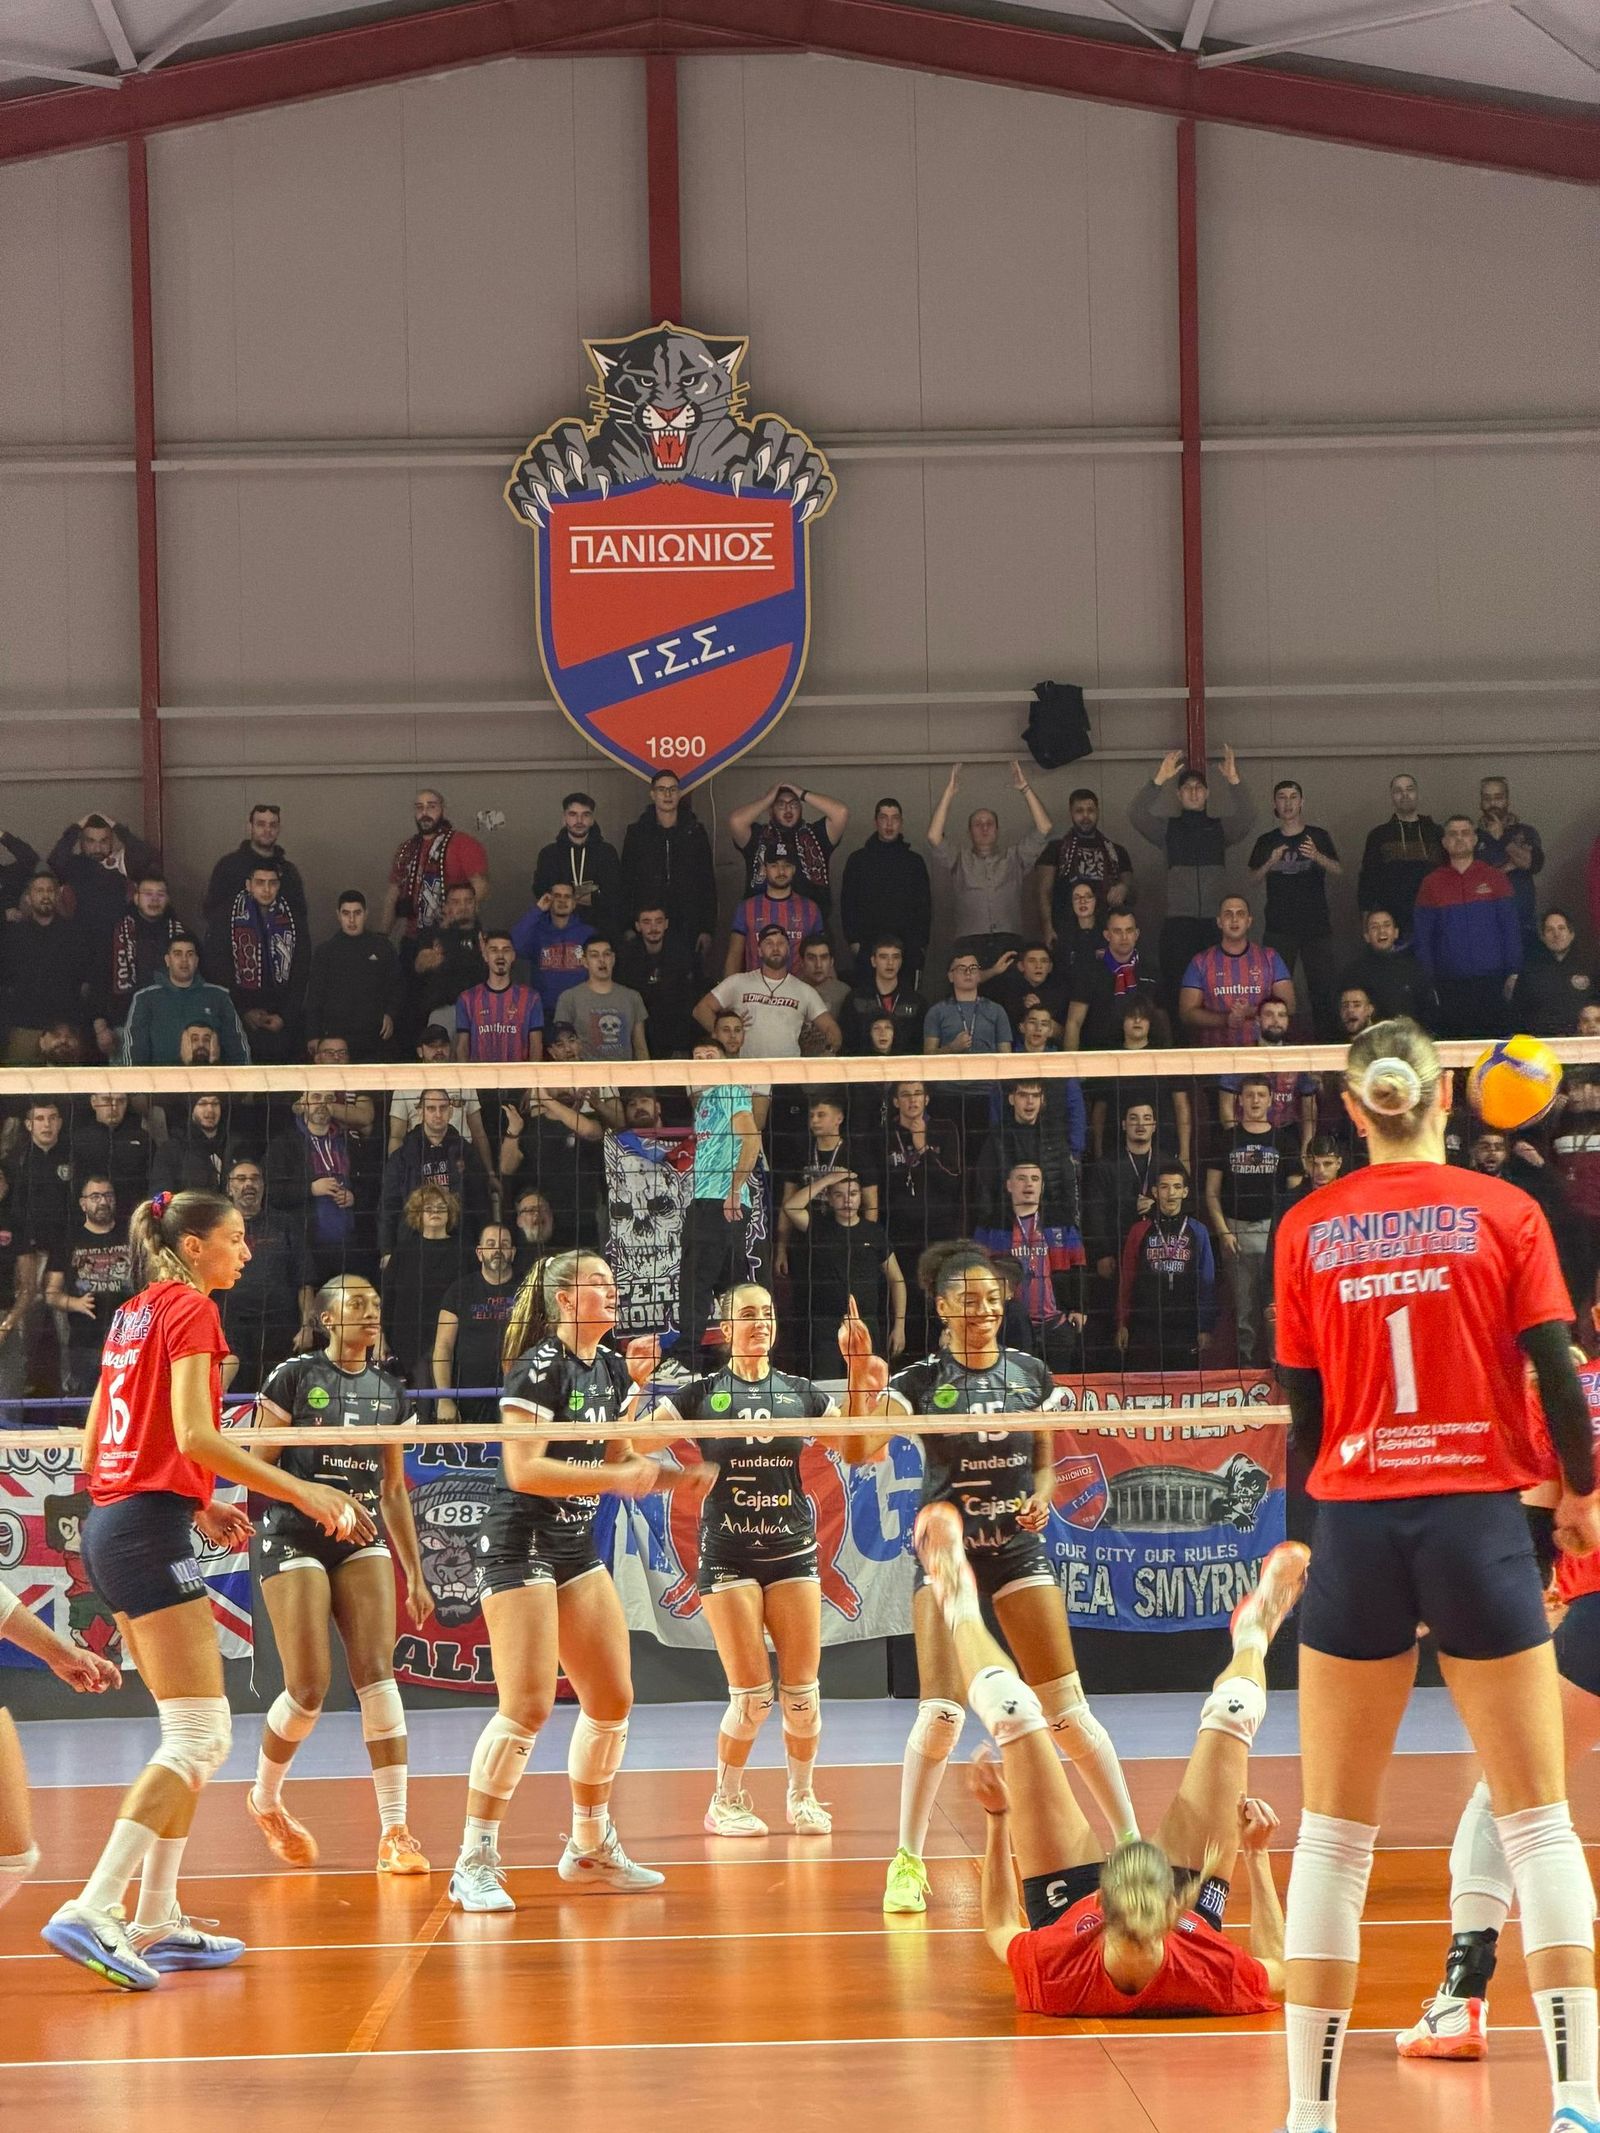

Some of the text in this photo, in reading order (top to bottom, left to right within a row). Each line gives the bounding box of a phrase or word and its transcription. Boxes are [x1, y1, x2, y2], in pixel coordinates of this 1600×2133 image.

[570, 532, 773, 564] ΠΑΝΙΩΝΙΟΣ
[627, 625, 736, 685] Γ.Σ.Σ.
[646, 735, 706, 759] 1890
[1213, 983, 1262, 996] panthers
[478, 1022, 517, 1035] panthers
[1308, 1204, 1482, 1254] PANIONIOS
[1338, 1266, 1451, 1304] RISTICEVIC
[1384, 1305, 1419, 1415] 1
[730, 1456, 794, 1469] Fundación
[733, 1488, 793, 1512] Cajasol
[432, 1503, 491, 1525] 1983
[719, 1512, 795, 1536] Andalucía
[1055, 1543, 1239, 1563] OUR CITY OUR RULES
[1133, 1557, 1265, 1619] SMYRN
